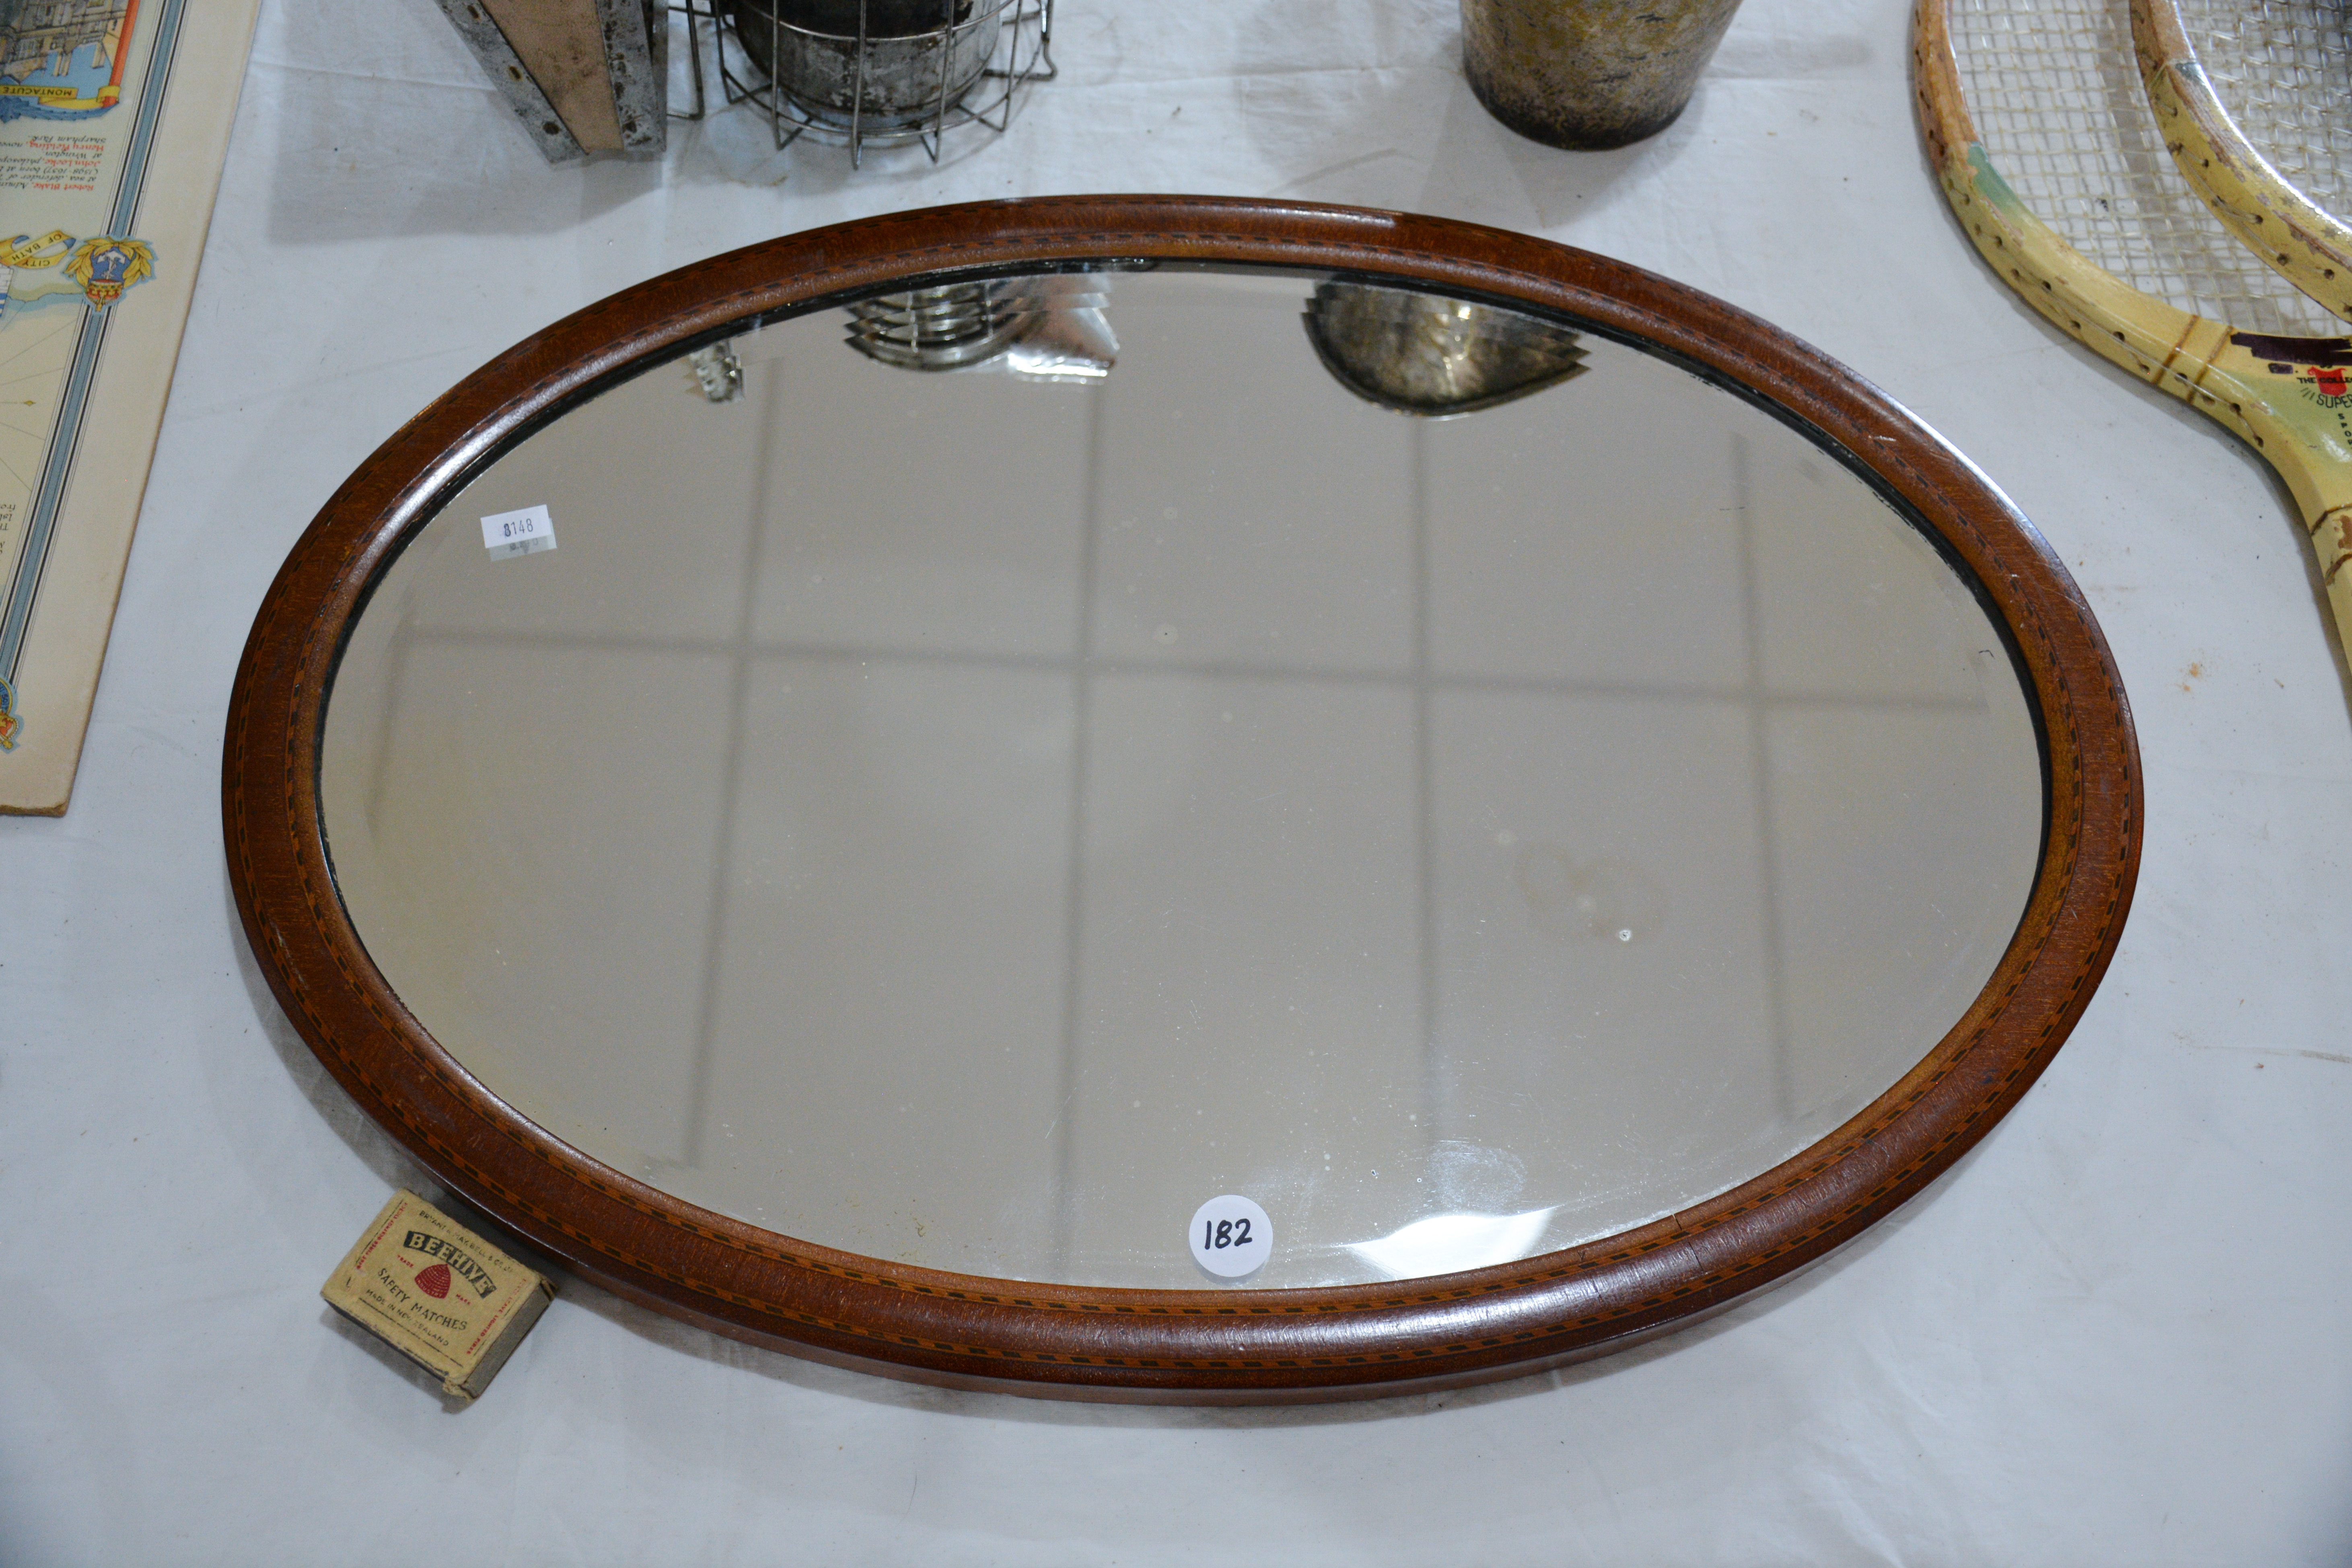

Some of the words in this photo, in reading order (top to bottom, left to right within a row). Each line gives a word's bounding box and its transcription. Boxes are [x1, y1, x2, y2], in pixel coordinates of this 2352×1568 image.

[3, 87, 72, 96] MONTACUTE
[73, 143, 104, 152] Henry
[0, 156, 43, 165] philosop
[48, 234, 62, 244] OF
[12, 243, 40, 261] BATH
[504, 518, 533, 537] 8148
[419, 1210, 446, 1230] BRYANT
[1204, 1218, 1253, 1250] 182
[407, 1232, 494, 1296] BEEHIVE
[397, 1255, 415, 1268] TRADE
[456, 1294, 471, 1306] MARK
[416, 1278, 443, 1298] INDUSTRY
[366, 1289, 385, 1305] MADE
[378, 1268, 410, 1303] SAFETY
[411, 1303, 467, 1330] MATCHES
